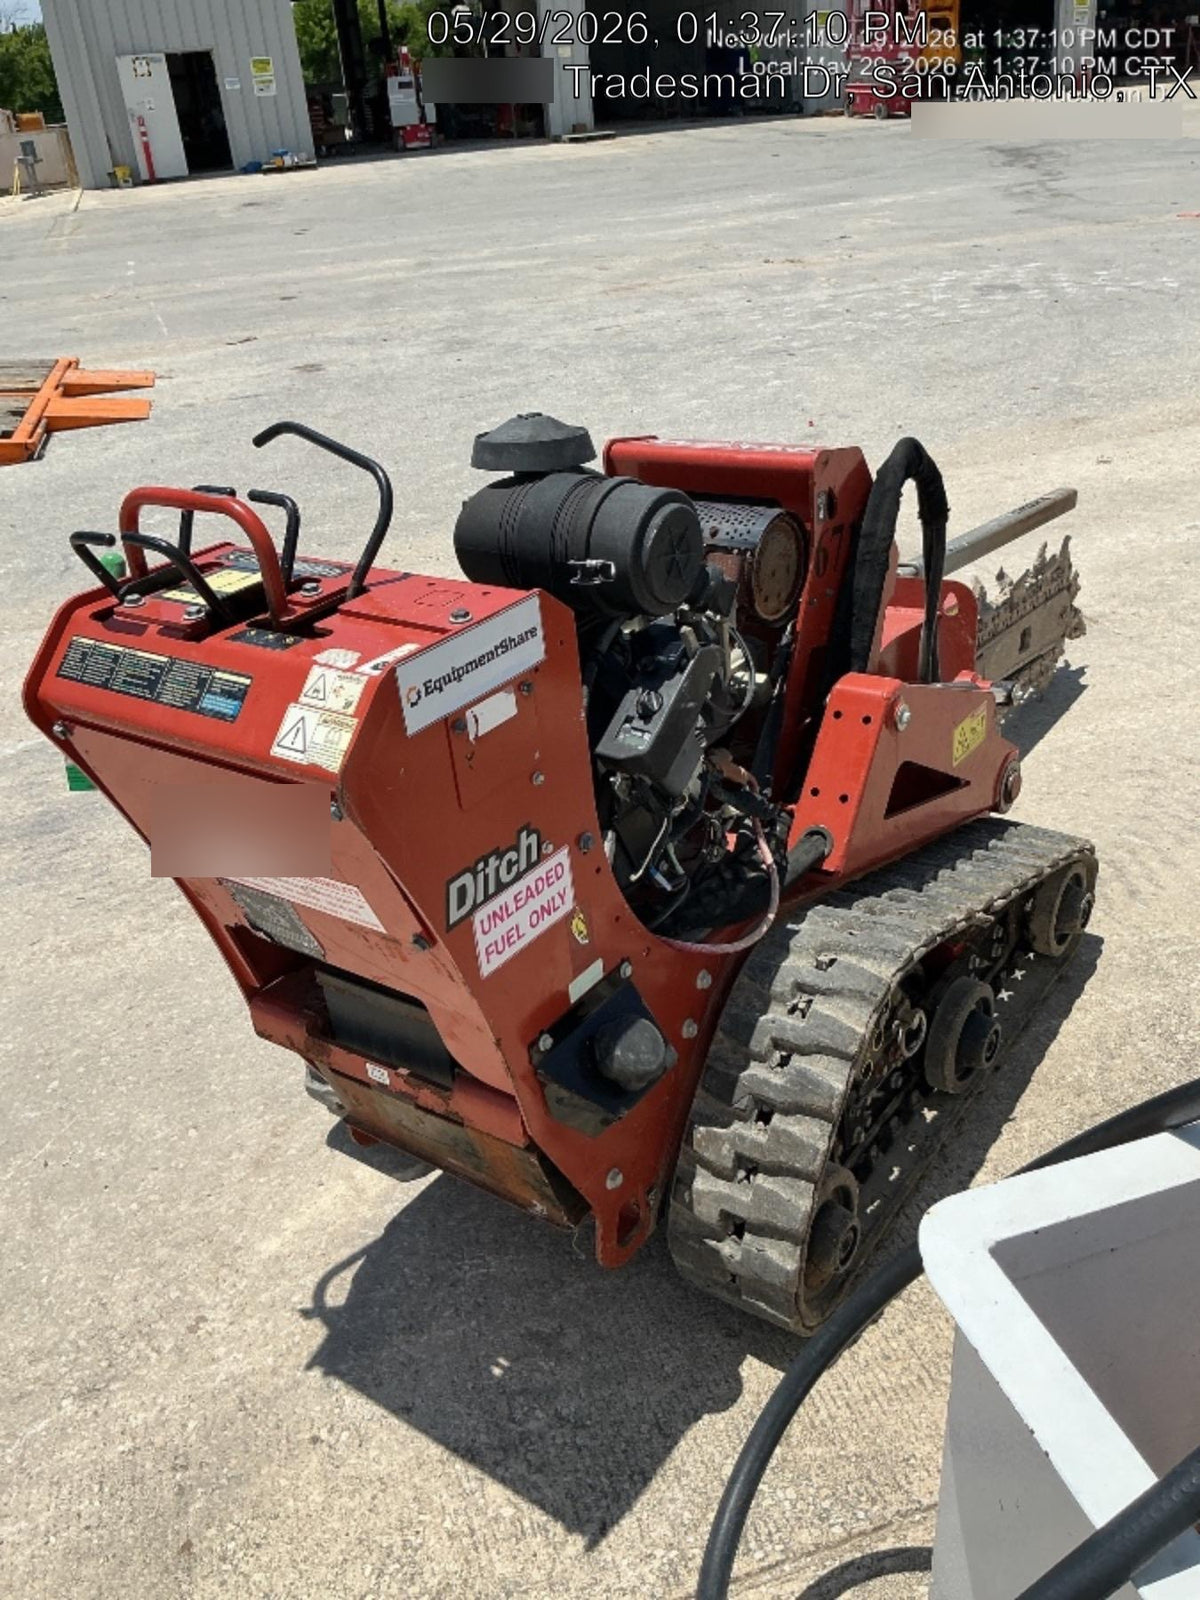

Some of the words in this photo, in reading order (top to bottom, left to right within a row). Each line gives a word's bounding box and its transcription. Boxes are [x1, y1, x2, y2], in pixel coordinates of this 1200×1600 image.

[422, 625, 538, 697] EquipmentShare
[448, 828, 539, 927] Ditch
[479, 861, 565, 935] UNLEADED
[484, 923, 526, 964] FUEL
[529, 887, 569, 929] ONLY
